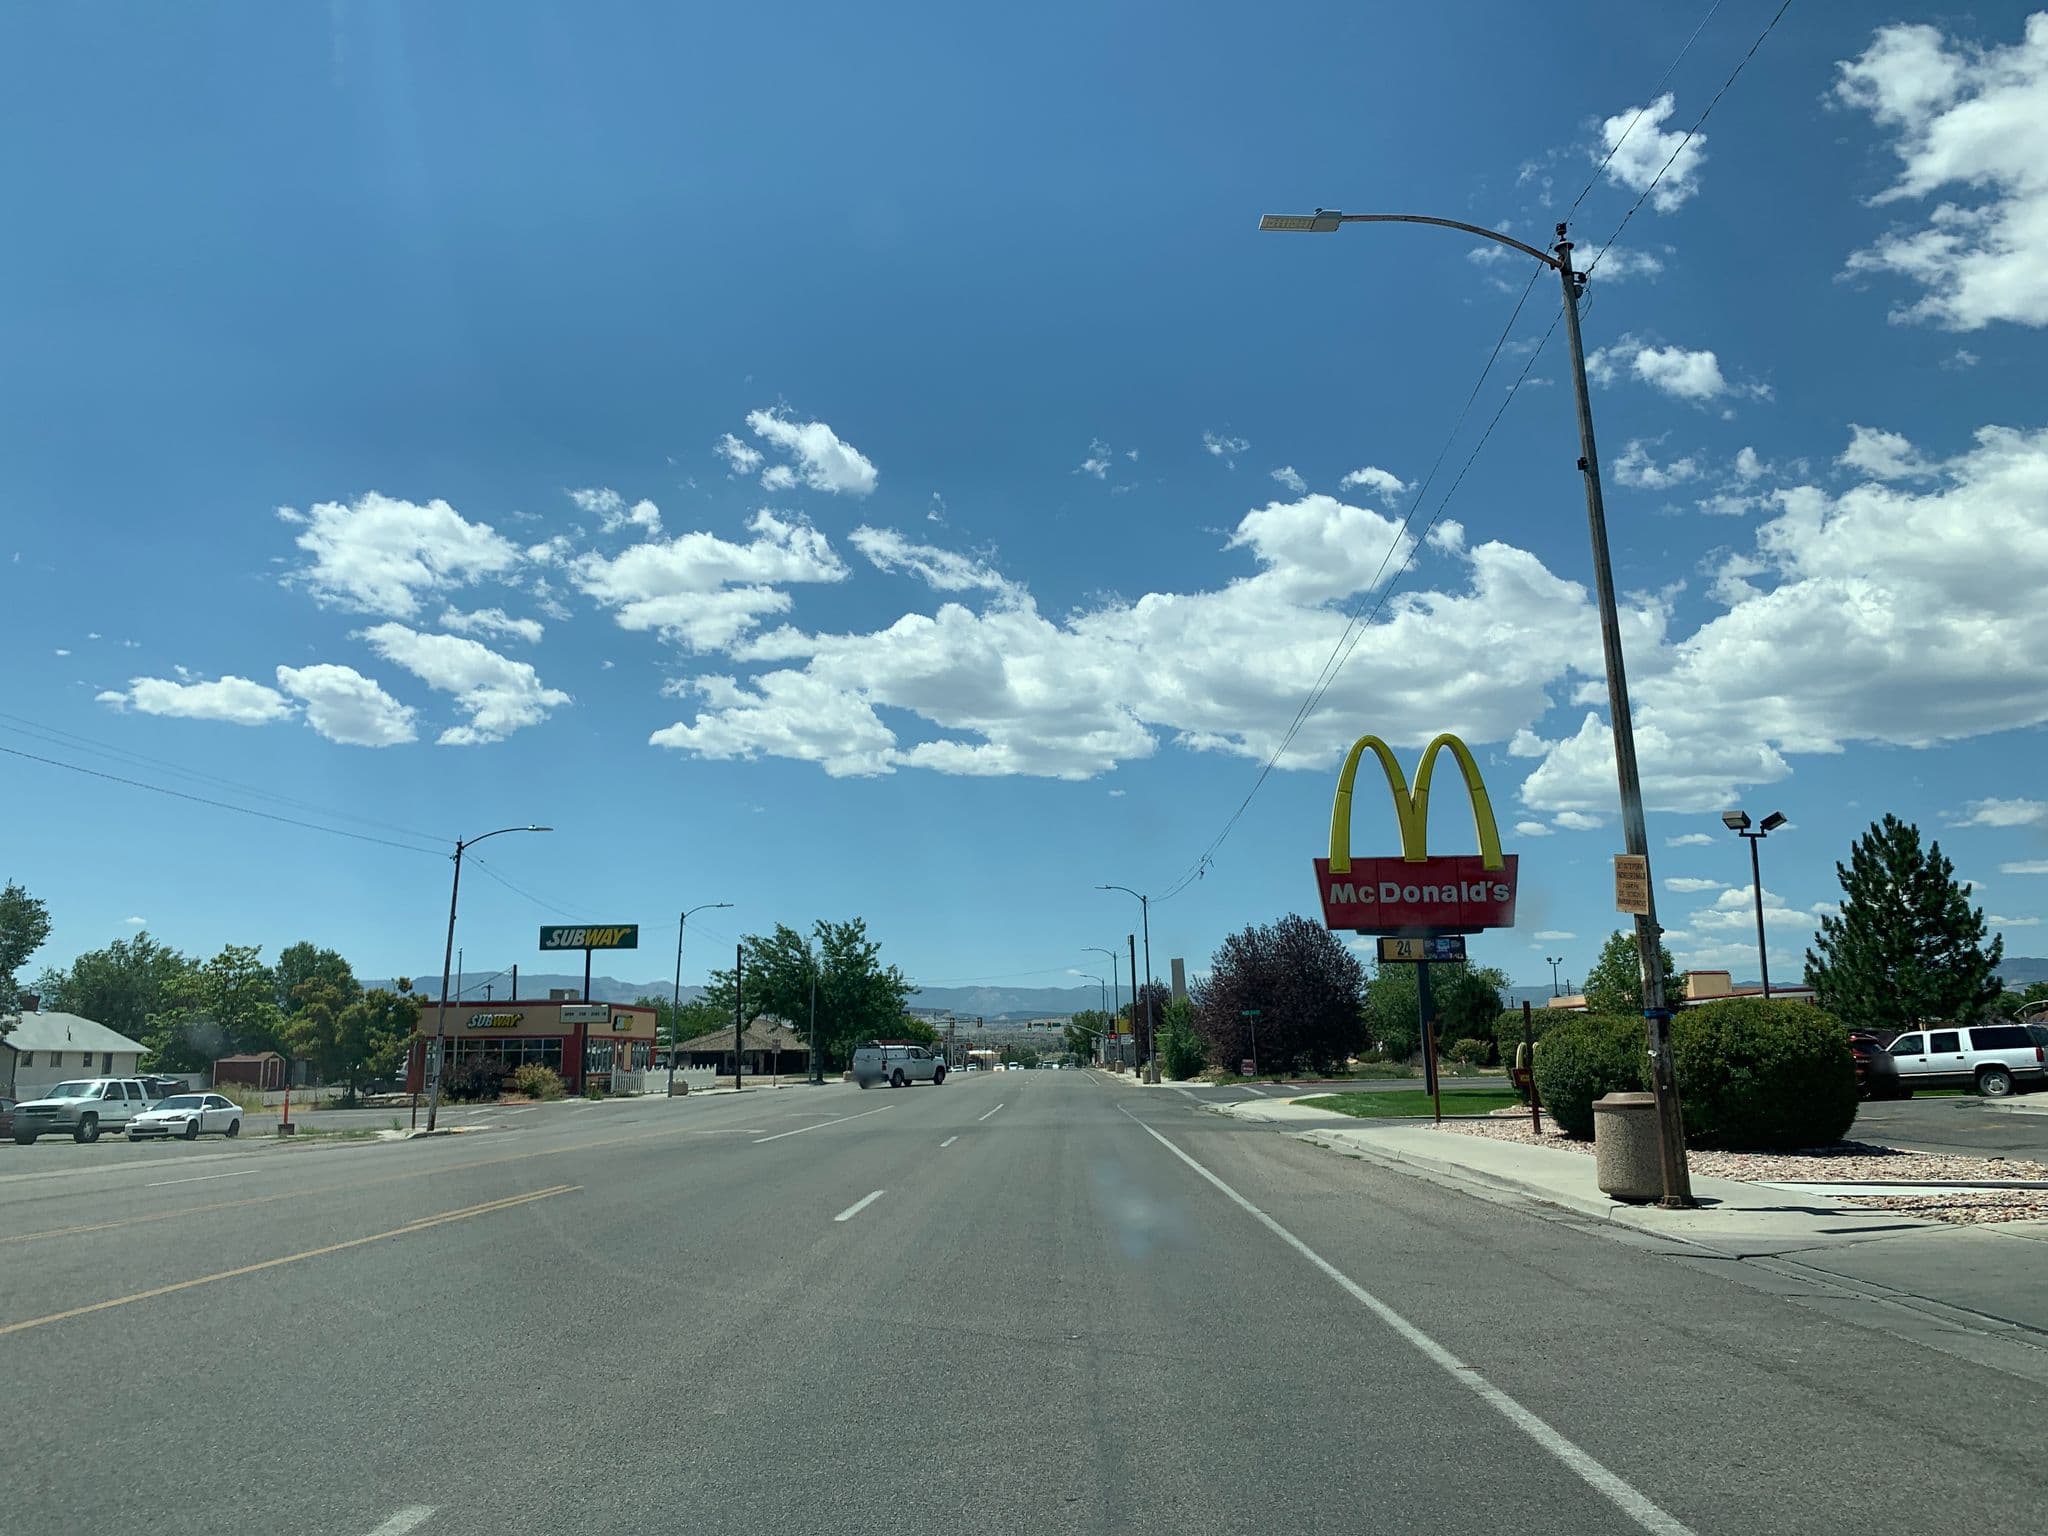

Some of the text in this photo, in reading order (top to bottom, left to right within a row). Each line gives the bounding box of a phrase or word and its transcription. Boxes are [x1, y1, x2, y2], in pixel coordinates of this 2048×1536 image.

[1329, 880, 1511, 905] McDonald's
[546, 928, 631, 947] SUBWAY
[1396, 940, 1412, 956] 24
[467, 1013, 523, 1028] SUBWAY
